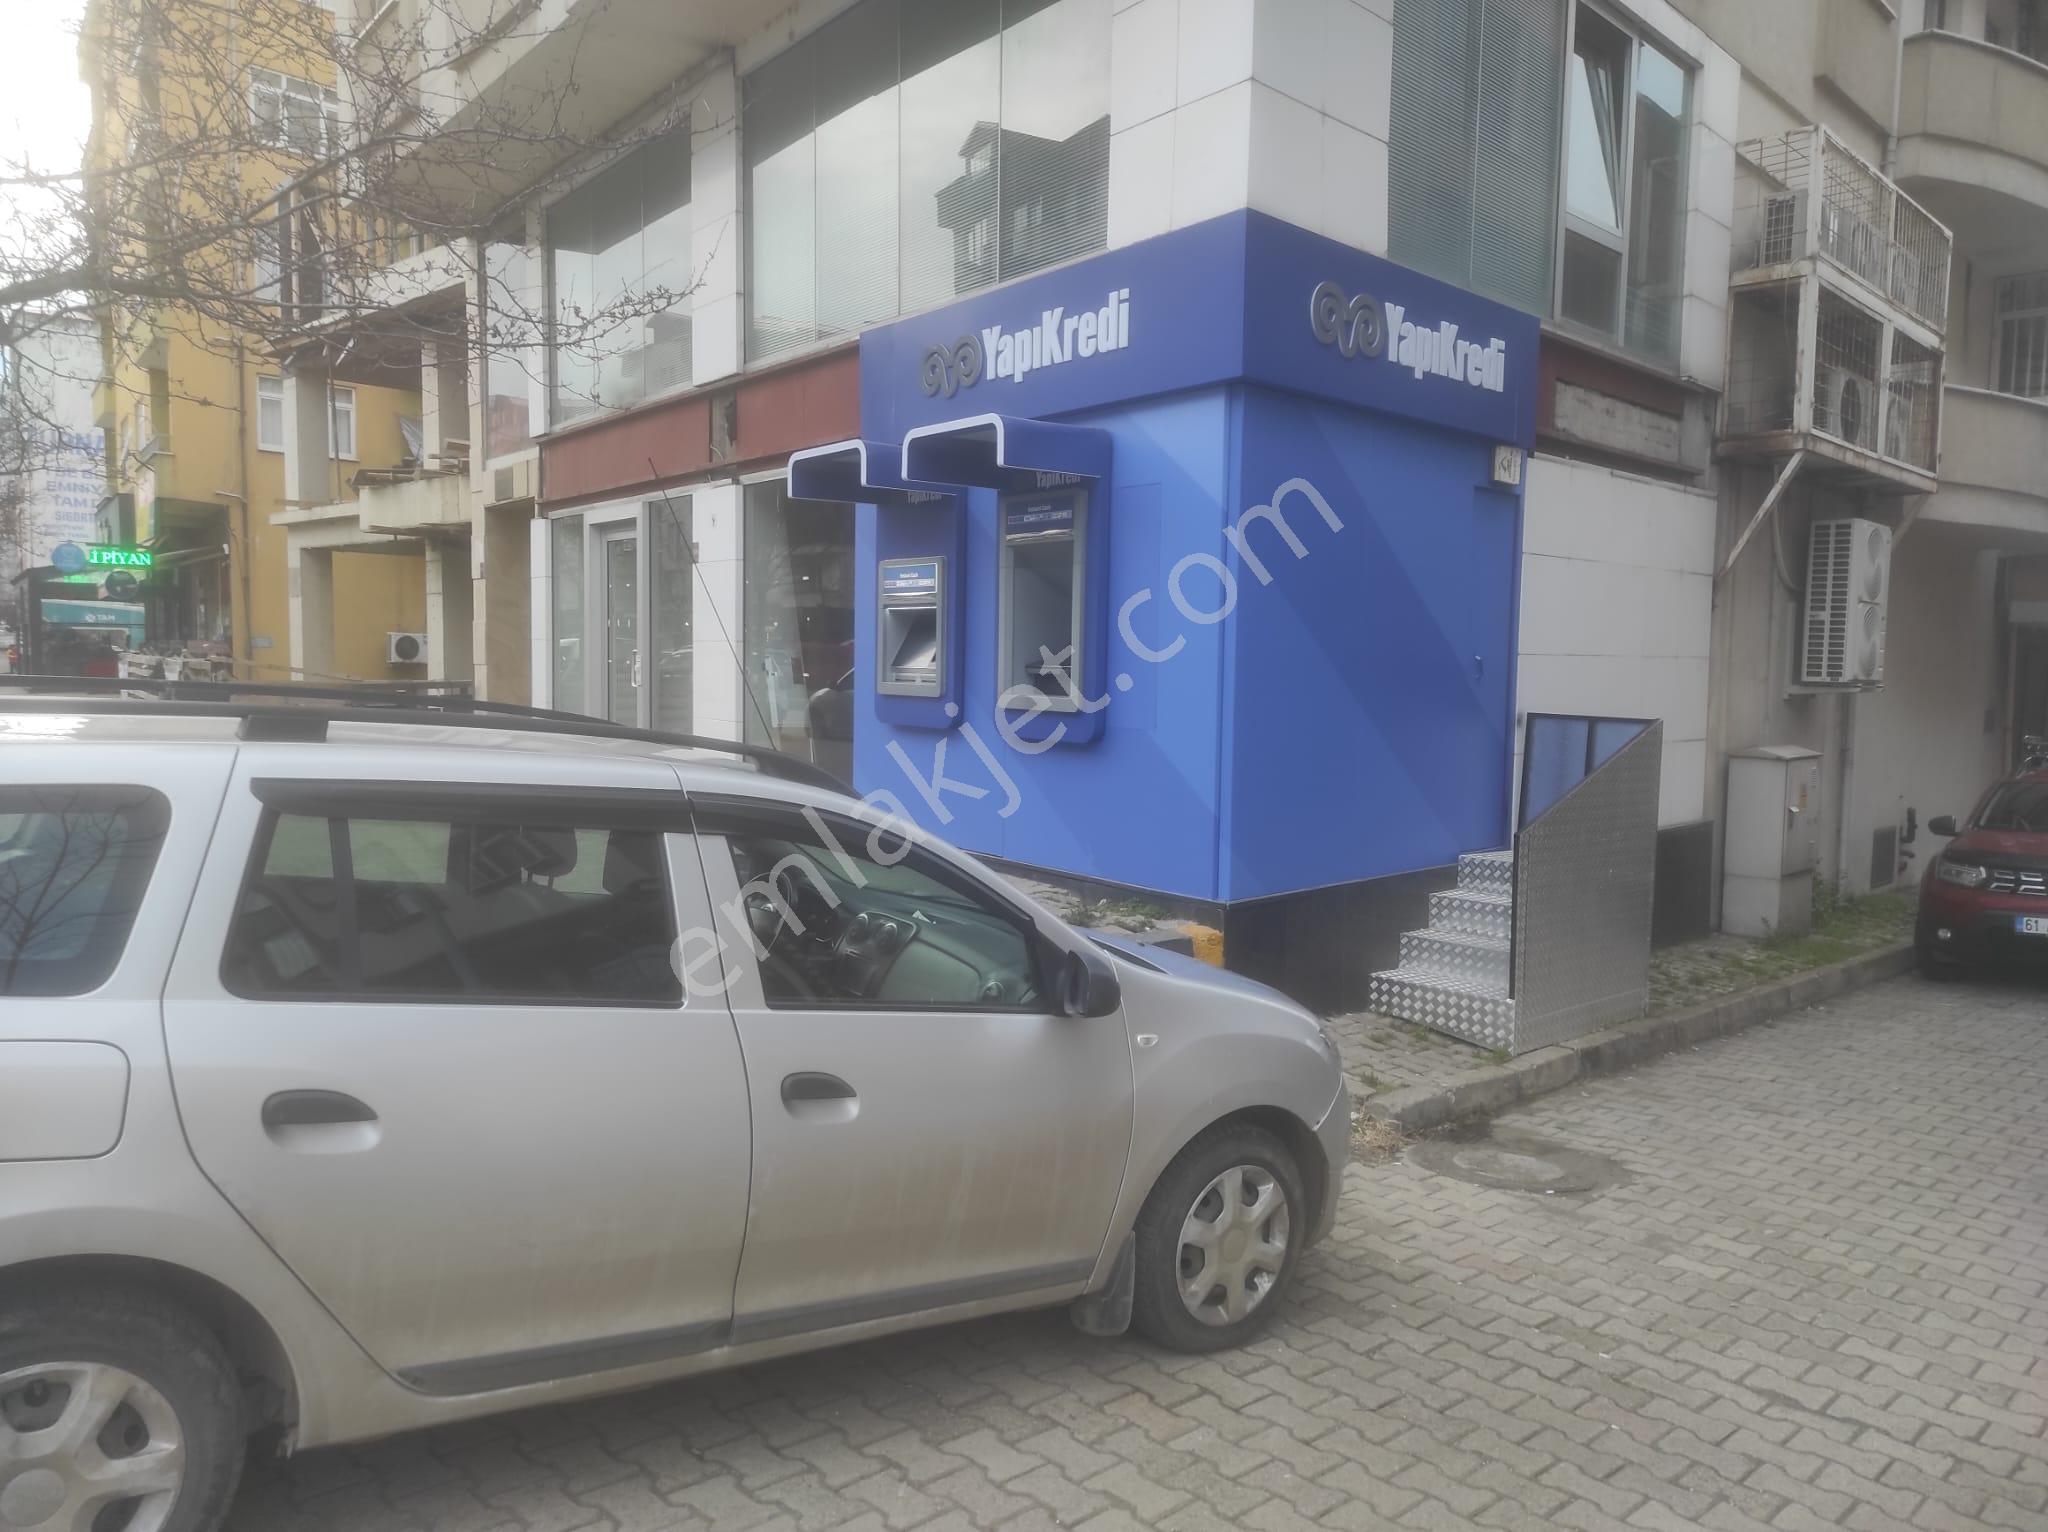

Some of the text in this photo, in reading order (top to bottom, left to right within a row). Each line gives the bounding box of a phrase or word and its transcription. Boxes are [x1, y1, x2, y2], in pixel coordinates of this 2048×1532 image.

[982, 288, 1130, 383] YapıKredi
[1385, 302, 1506, 392] YapıKredi
[102, 551, 151, 565] PİYAN
[2025, 918, 2039, 932] 61
